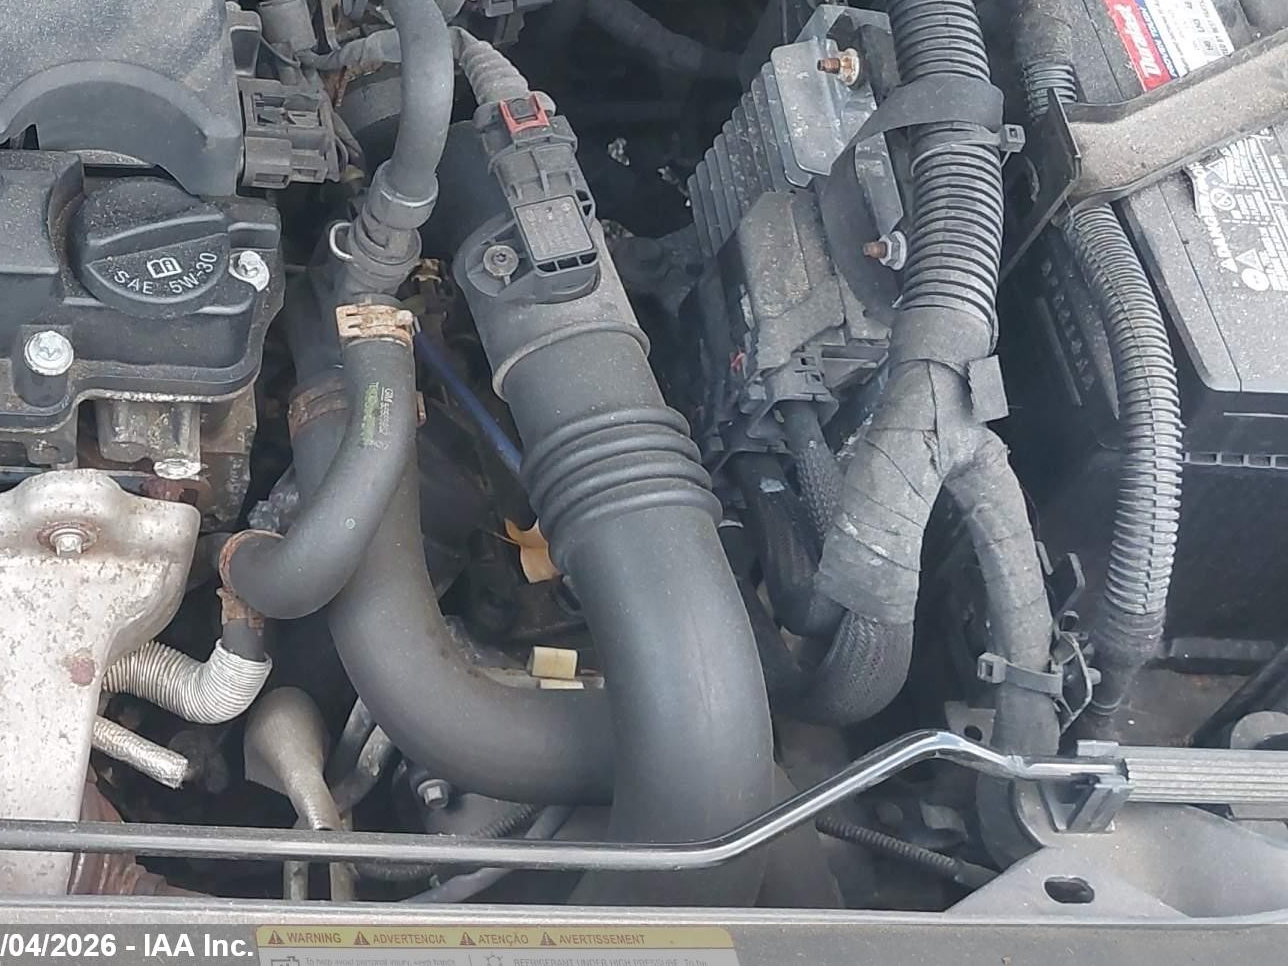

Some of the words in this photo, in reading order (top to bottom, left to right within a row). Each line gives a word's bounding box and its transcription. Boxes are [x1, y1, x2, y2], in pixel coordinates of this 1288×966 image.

[114, 270, 154, 295] SAE
[168, 252, 218, 295] 5W-30
[286, 933, 342, 944] WARNING
[373, 934, 447, 945] ADVERTENCIA
[559, 934, 646, 945] AVERTISSEMENT
